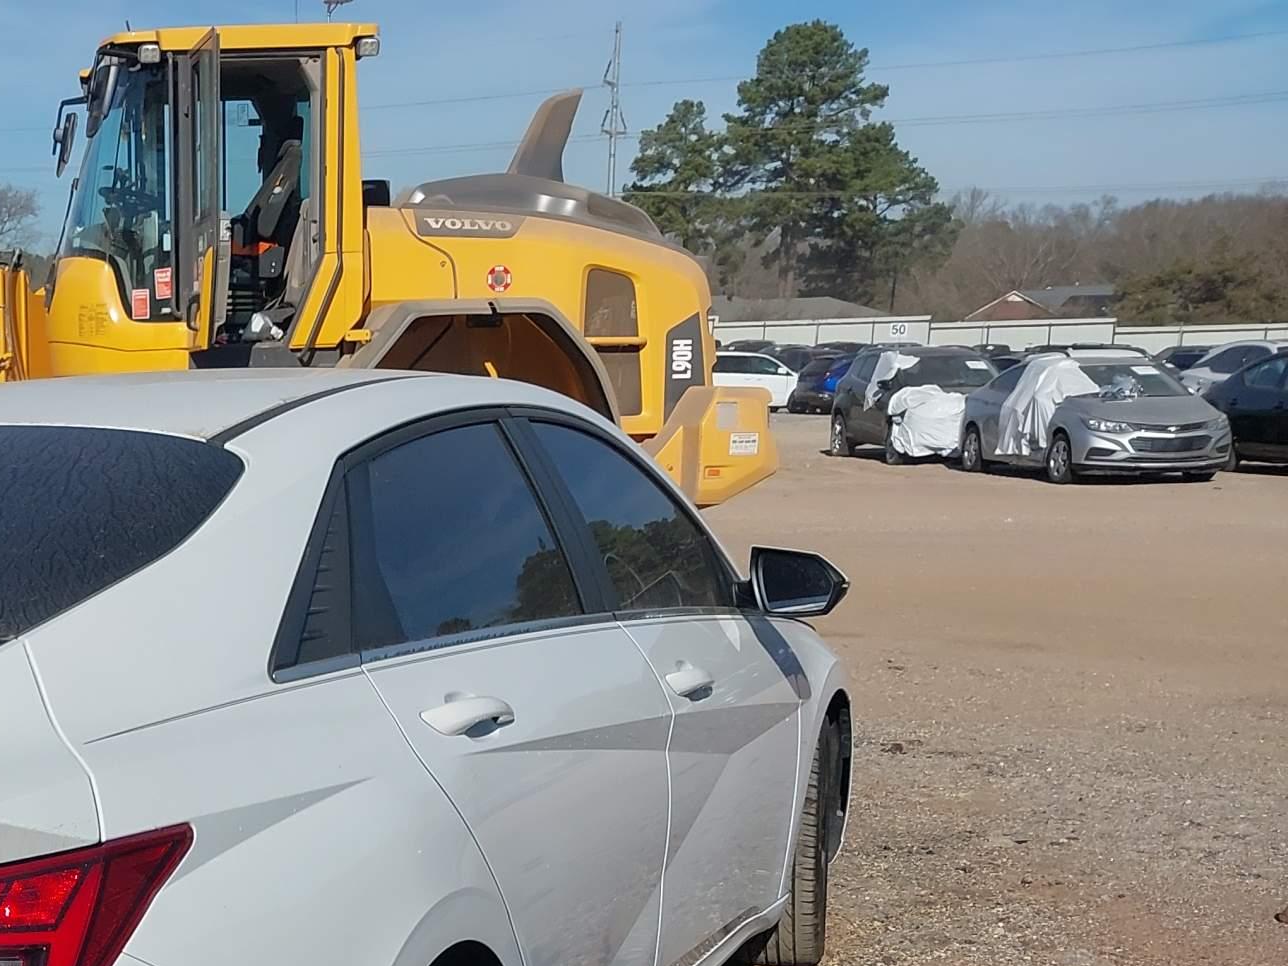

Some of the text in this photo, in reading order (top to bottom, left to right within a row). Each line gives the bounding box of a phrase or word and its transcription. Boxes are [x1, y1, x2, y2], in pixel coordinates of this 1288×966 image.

[424, 217, 512, 231] VOLVO
[891, 324, 906, 335] 50
[672, 339, 692, 379] L90H
